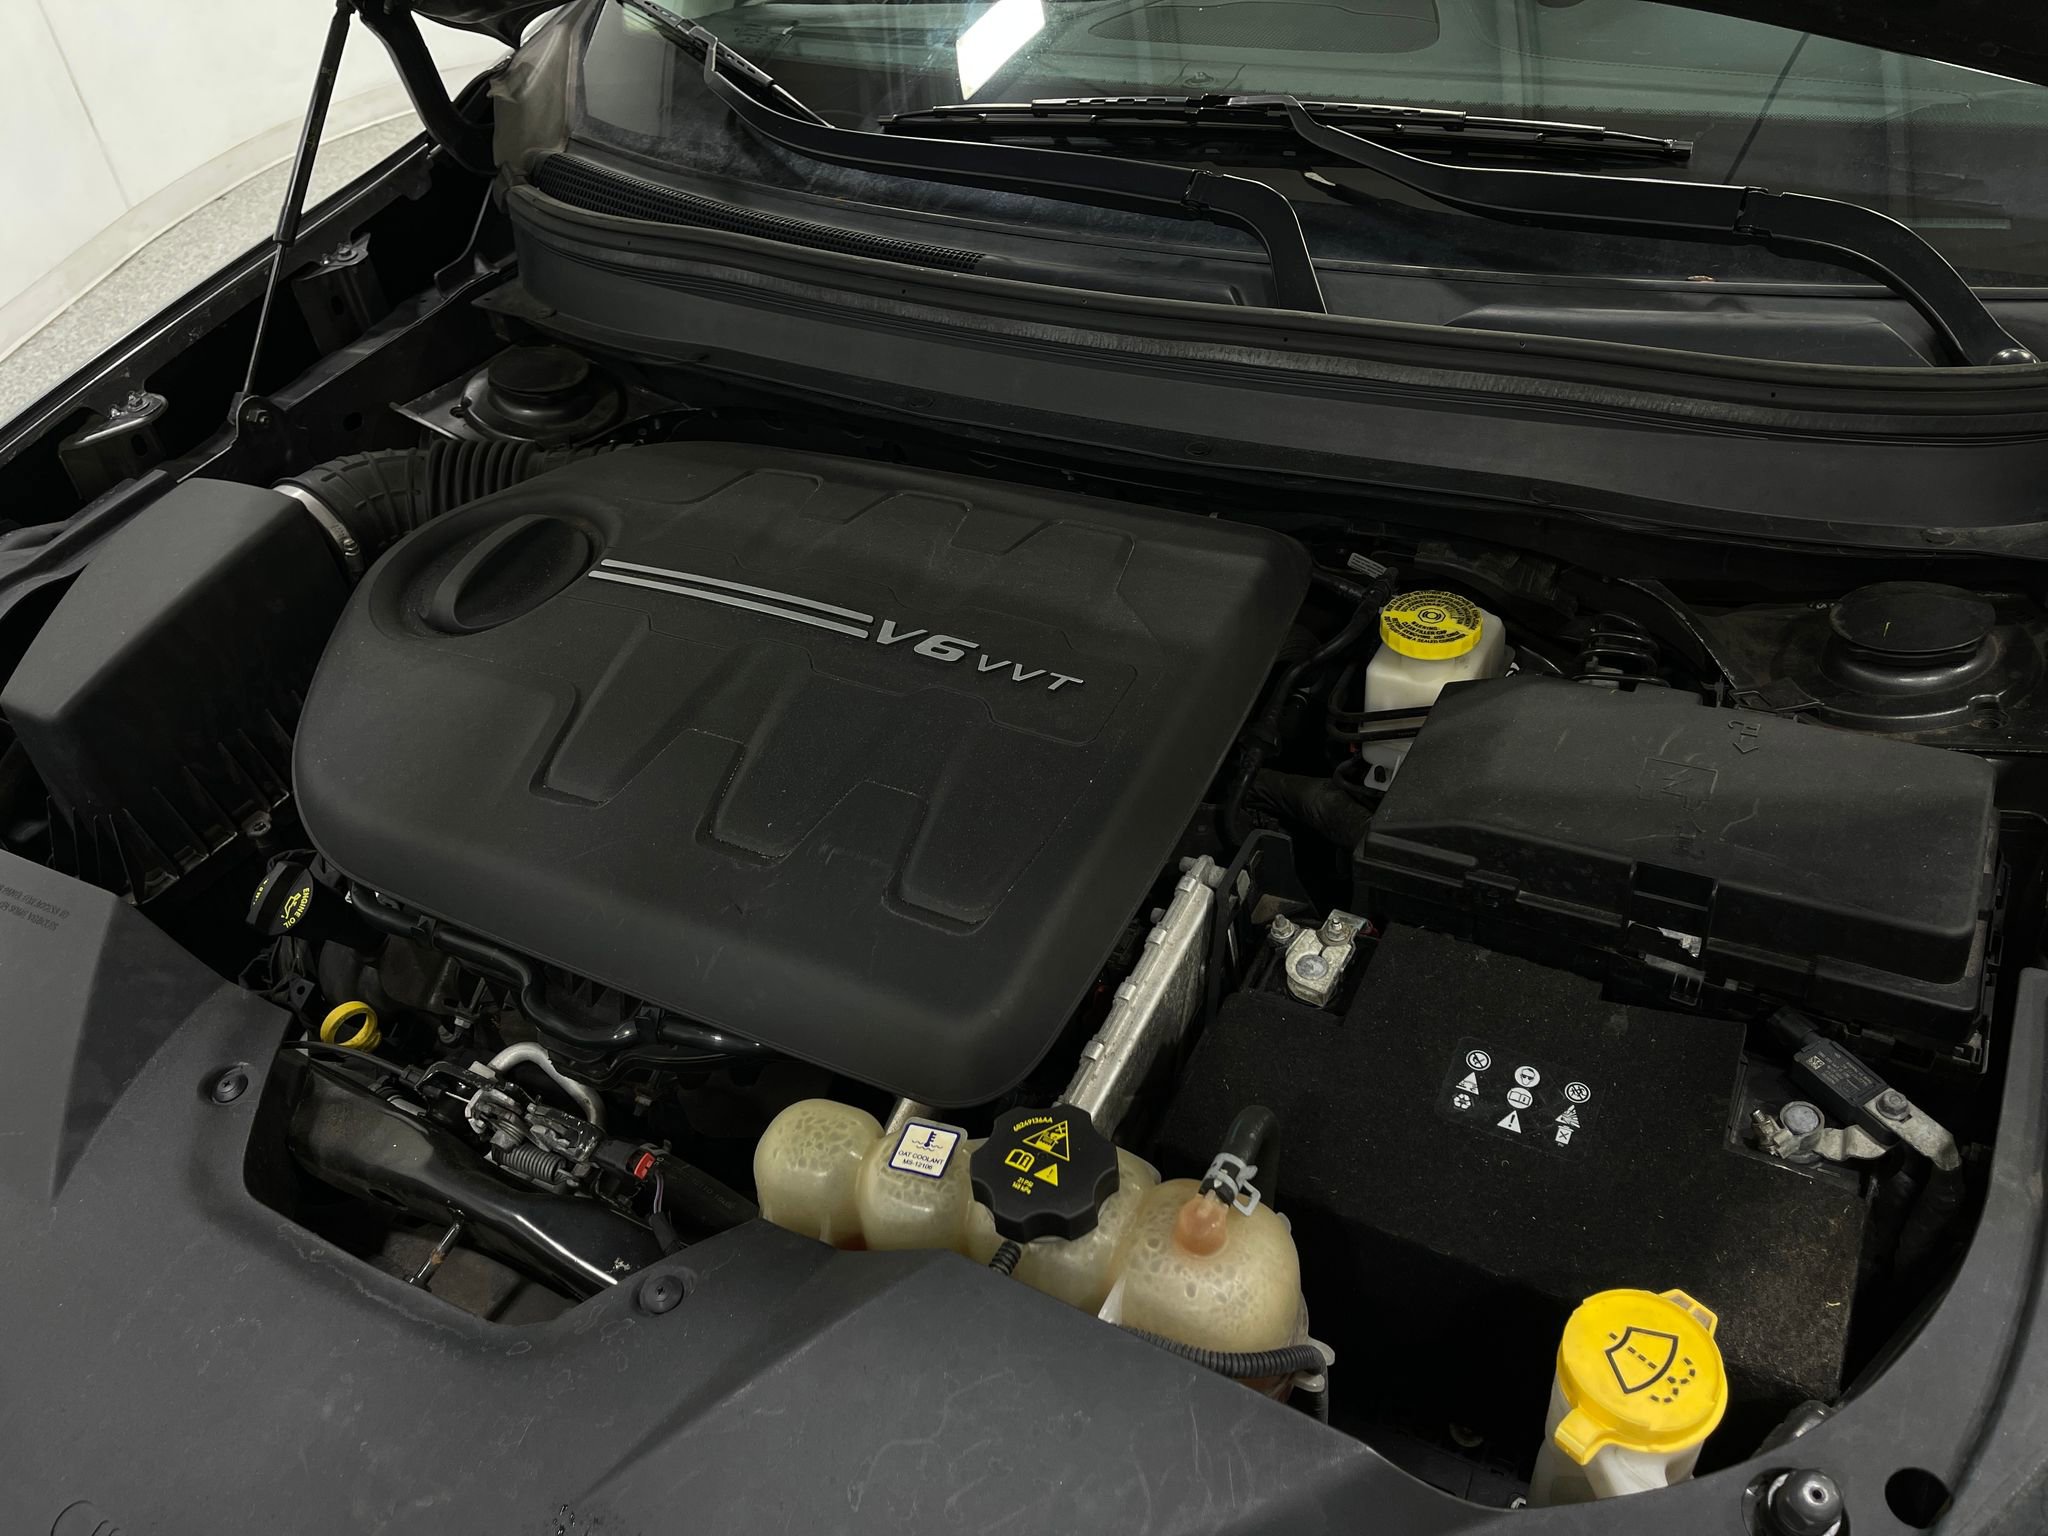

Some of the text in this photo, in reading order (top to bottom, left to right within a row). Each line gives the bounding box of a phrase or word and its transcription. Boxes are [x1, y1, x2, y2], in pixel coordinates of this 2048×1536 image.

[875, 618, 1085, 691] V6 VVT
[283, 887, 311, 928] ENGINE OIL
[897, 1150, 945, 1165] OAT COOLANT
